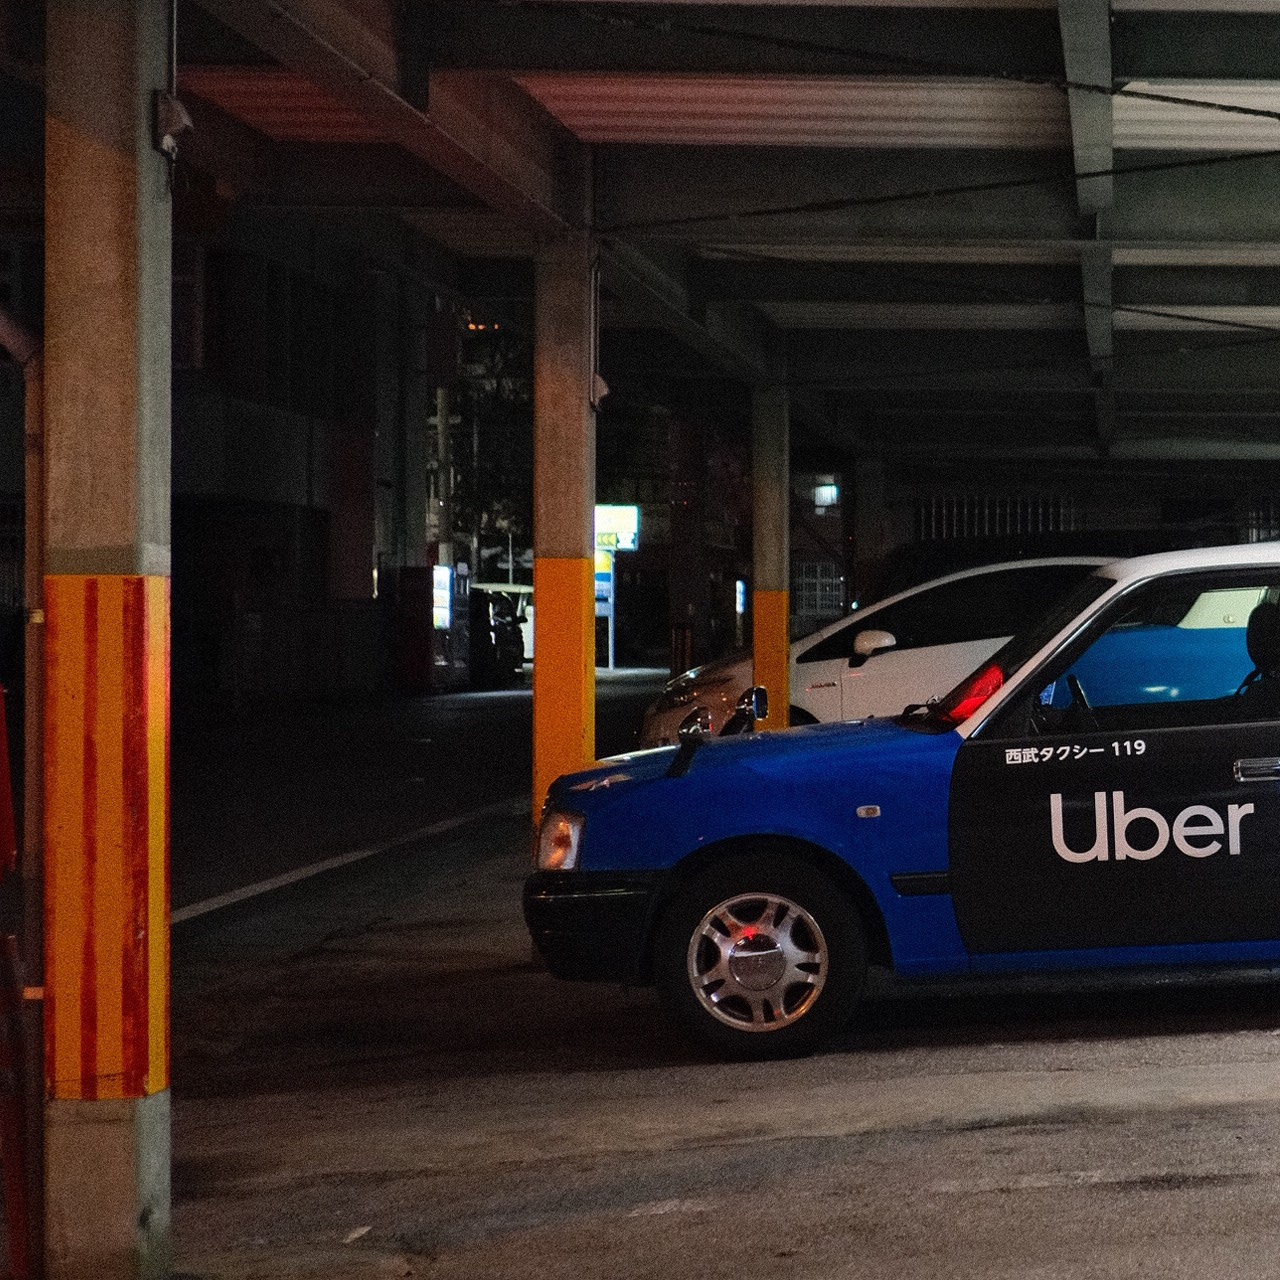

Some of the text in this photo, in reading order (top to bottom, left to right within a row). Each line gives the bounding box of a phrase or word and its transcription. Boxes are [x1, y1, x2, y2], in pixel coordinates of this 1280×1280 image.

[1005, 739, 1146, 764] 西武タクシー 119
[1050, 790, 1254, 864] Uber
